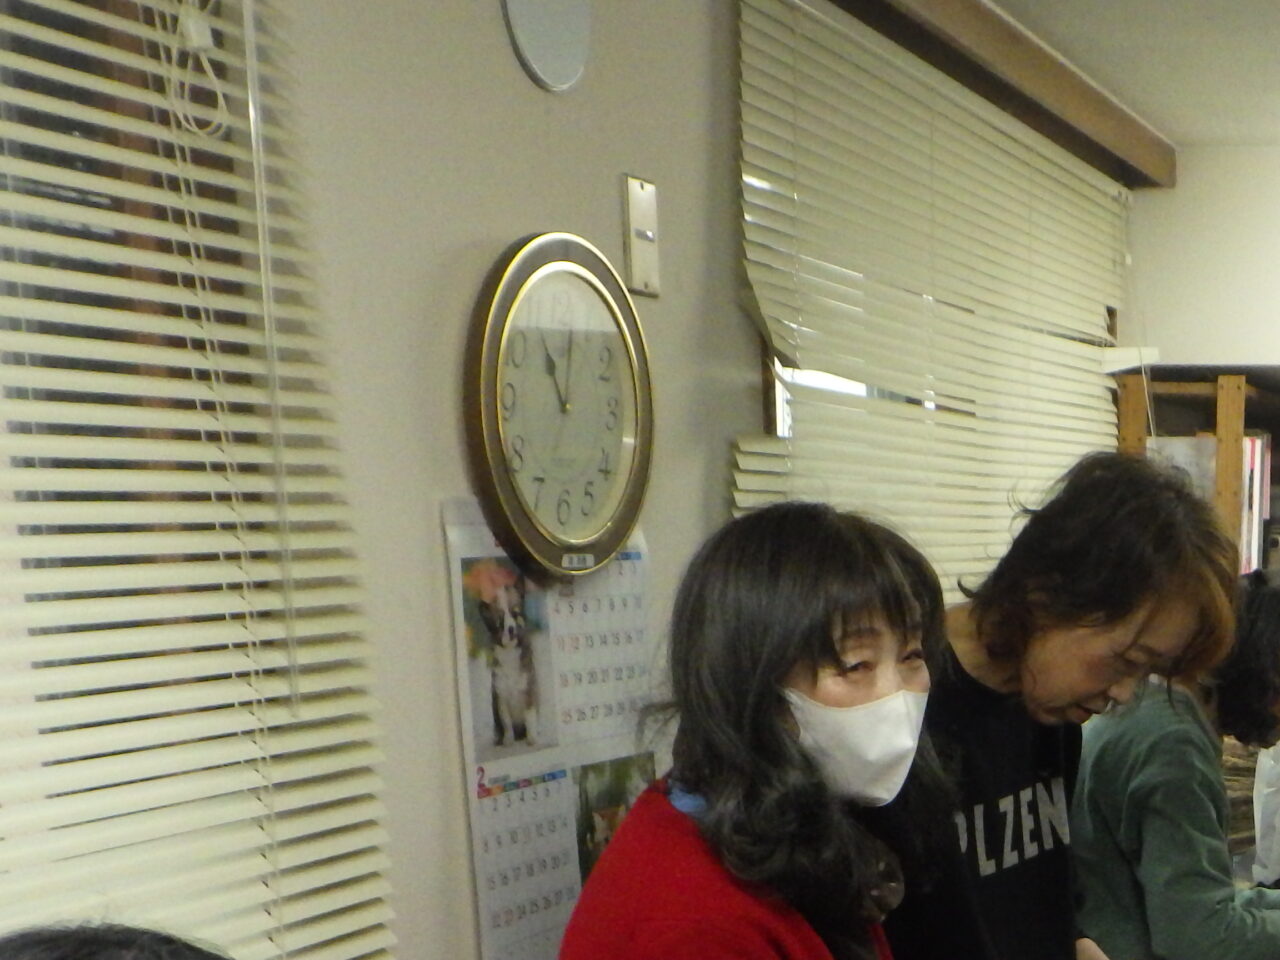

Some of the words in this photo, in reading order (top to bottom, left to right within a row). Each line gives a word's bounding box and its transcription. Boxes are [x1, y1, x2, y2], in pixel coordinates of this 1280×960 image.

[598, 345, 612, 382] 2
[502, 381, 515, 422] 9
[597, 446, 611, 481] 4
[532, 474, 545, 513] 7
[556, 488, 570, 526] 6
[581, 481, 594, 517] 5
[477, 766, 486, 790] 2
